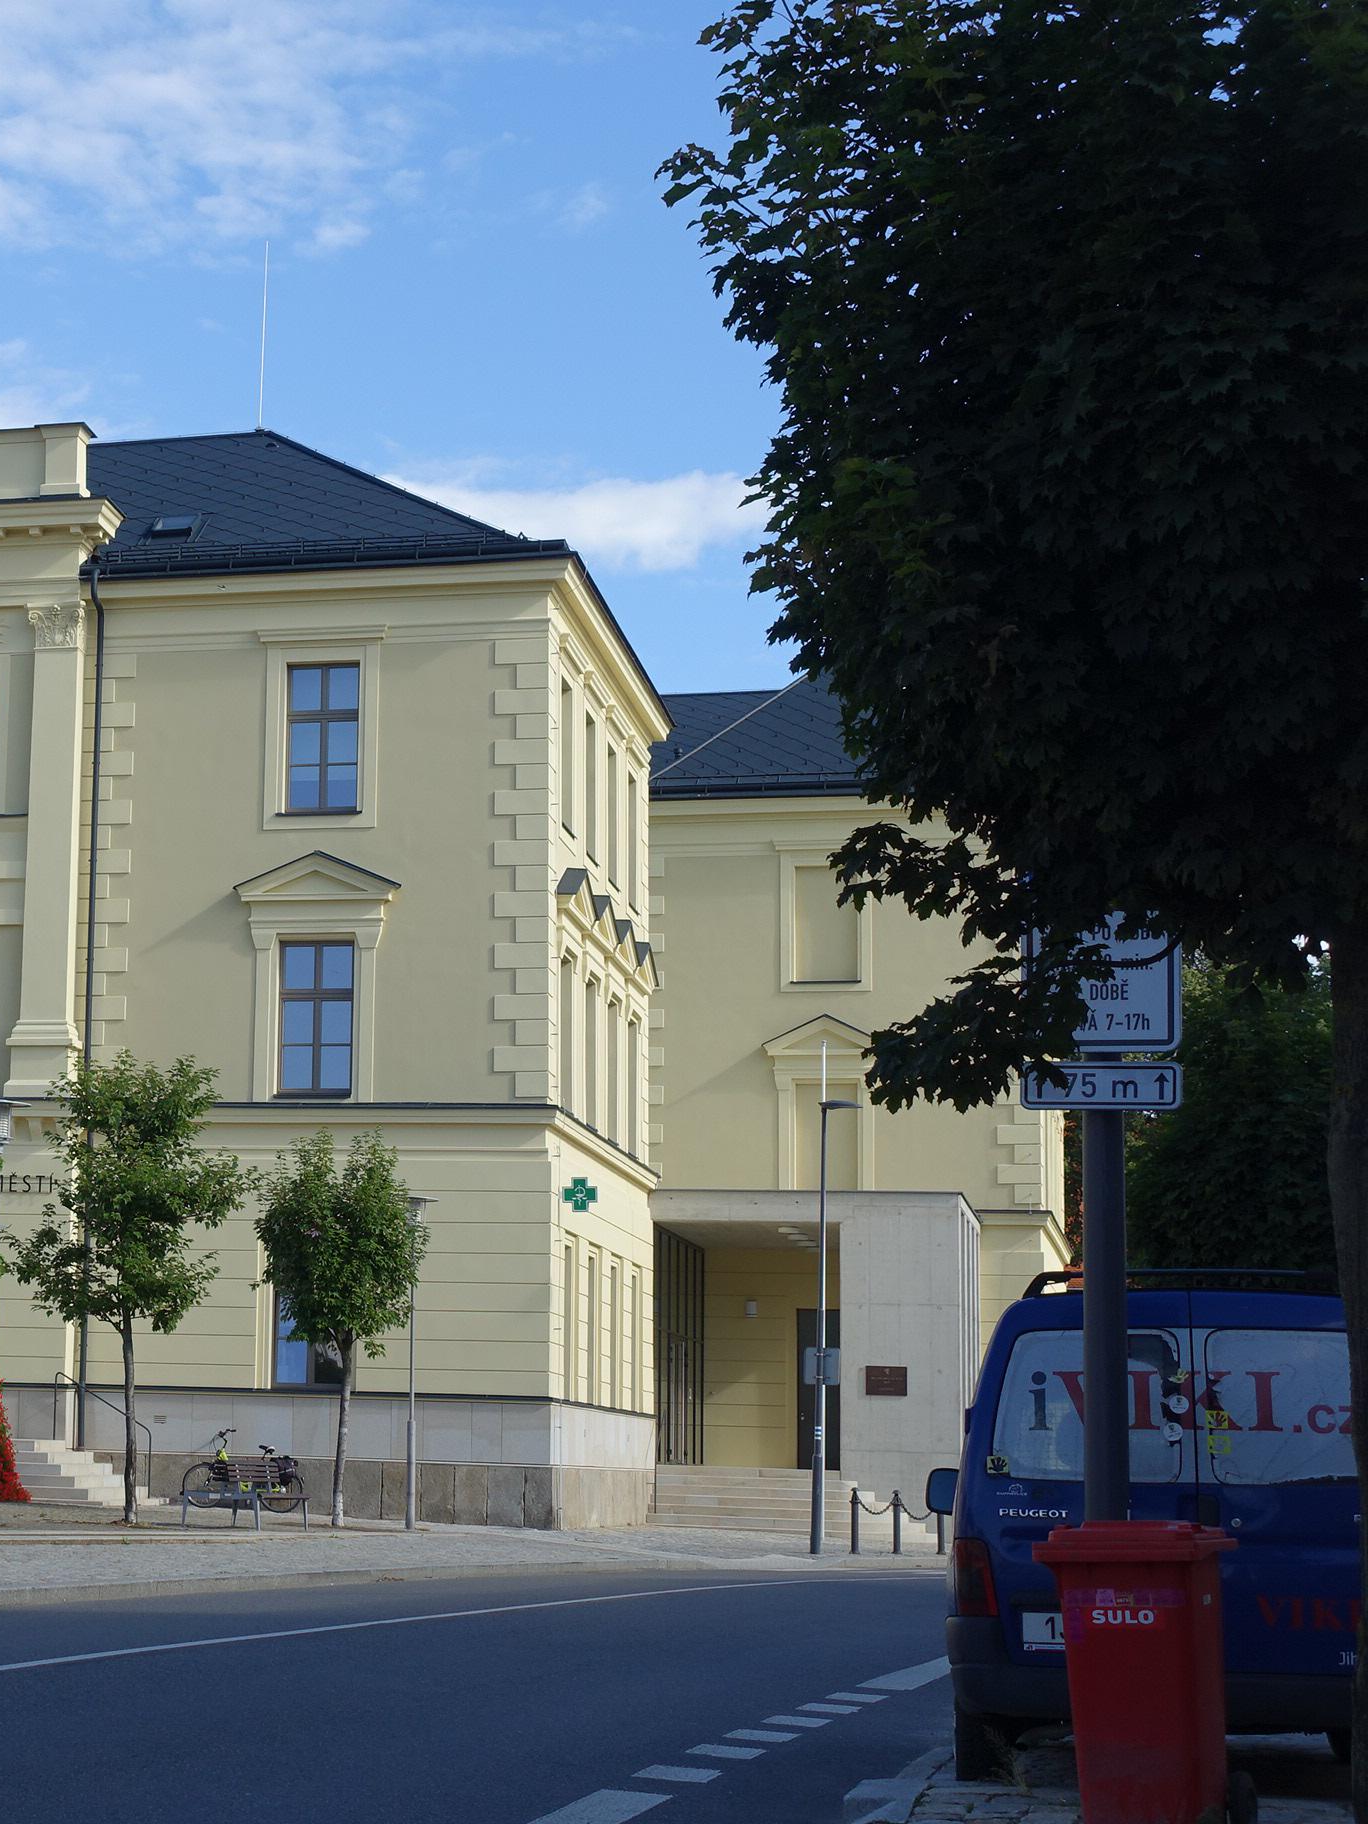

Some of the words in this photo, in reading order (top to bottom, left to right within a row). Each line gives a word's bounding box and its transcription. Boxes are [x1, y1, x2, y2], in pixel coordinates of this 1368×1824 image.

[1090, 979, 1129, 1001] DOBĚ
[1064, 1072, 1097, 1098] 75
[1111, 1081, 1138, 1098] m
[999, 1508, 1069, 1518] PEUGEOT
[1091, 1608, 1155, 1625] SULO
